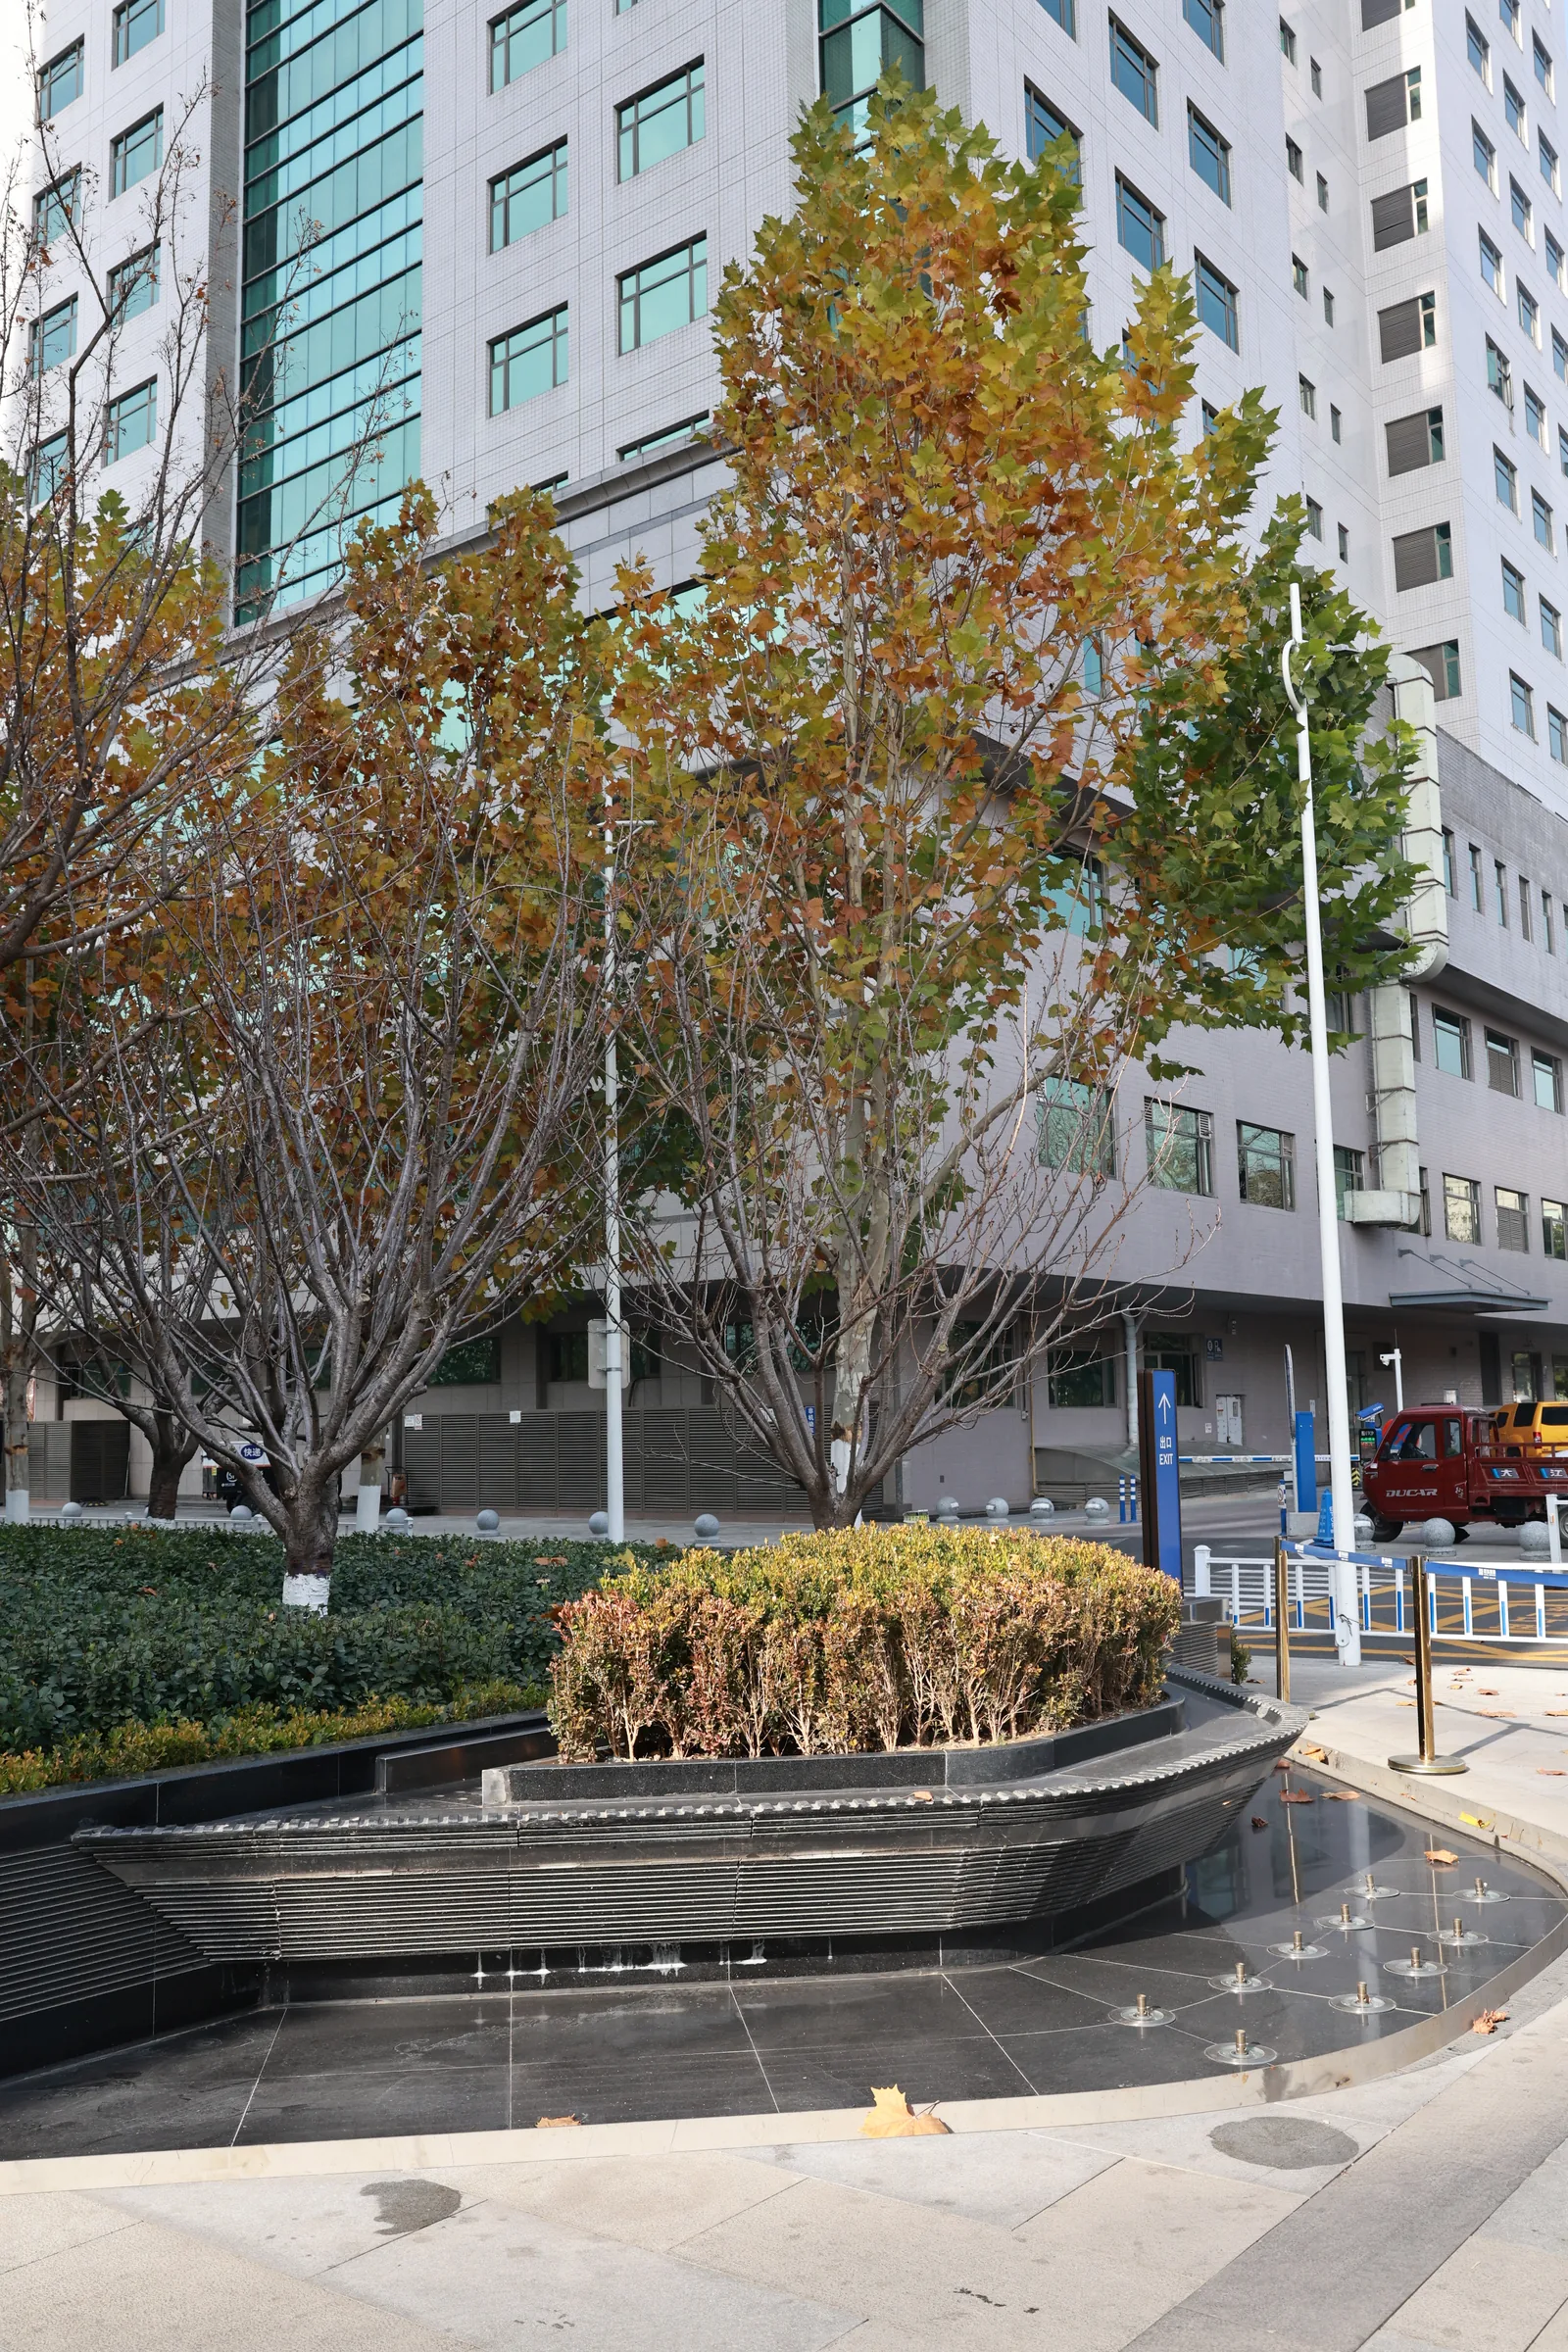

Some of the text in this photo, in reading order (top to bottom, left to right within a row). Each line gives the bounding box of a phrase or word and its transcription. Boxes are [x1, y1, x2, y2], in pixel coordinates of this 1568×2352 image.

[1159, 1435, 1172, 1449] 出口
[243, 1447, 262, 1457] 快递
[1158, 1453, 1174, 1466] EXIT
[1386, 1488, 1438, 1497] DUCAR
